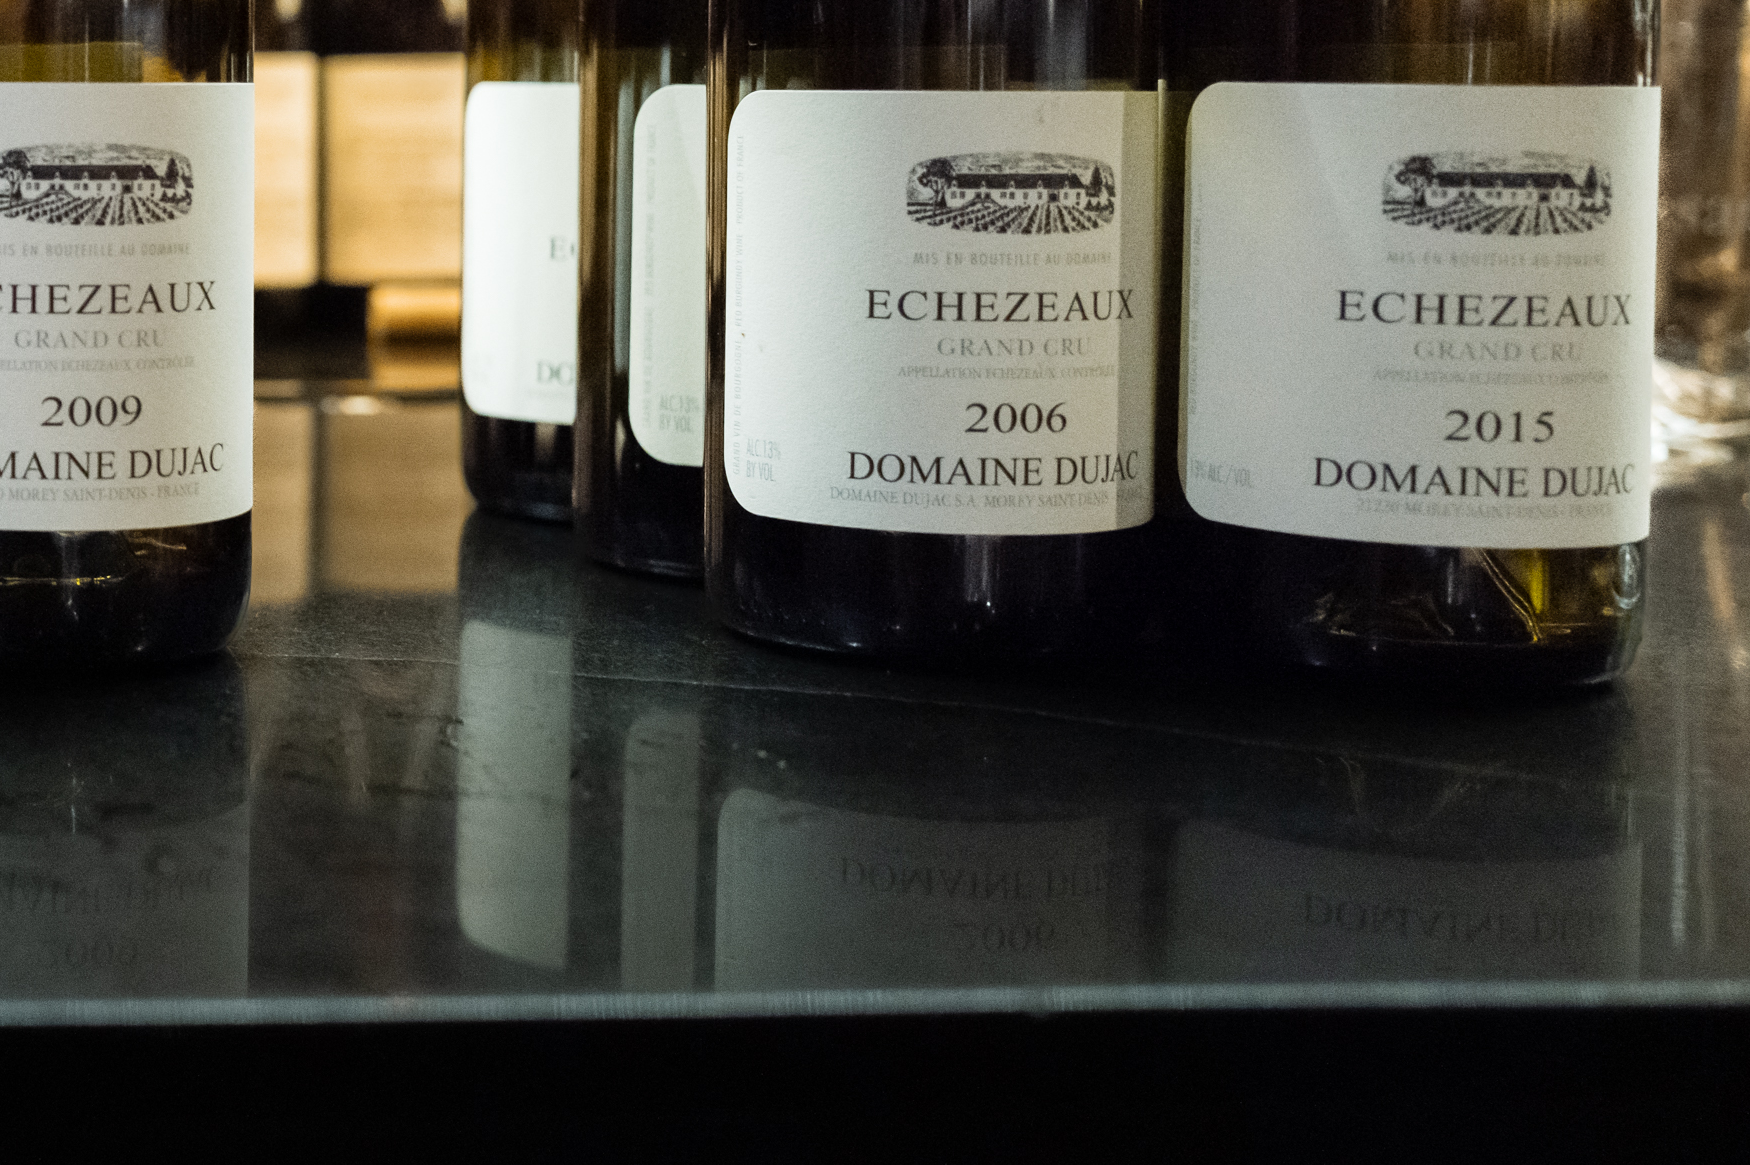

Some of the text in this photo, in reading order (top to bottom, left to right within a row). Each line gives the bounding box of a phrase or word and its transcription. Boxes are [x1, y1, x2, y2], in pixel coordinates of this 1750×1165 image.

[22, 243, 38, 256] EN
[46, 242, 113, 257] BOUTEILLE
[913, 252, 939, 265] MIS
[946, 253, 964, 265] EN
[970, 252, 1040, 266] BOUTEILLE
[1045, 252, 1061, 265] AU
[866, 288, 1134, 323] ECHEZEAUX
[1335, 288, 1633, 327] ECHEZEAUX
[14, 329, 165, 350] GRAND CRU
[936, 336, 1092, 357] GRAND CRU
[1413, 339, 1582, 362] GRAND CRU
[41, 395, 143, 428] 2009
[964, 402, 1068, 434] 2006
[1444, 409, 1554, 443] 2015
[129, 442, 225, 479] DUJAC
[746, 460, 756, 478] BY
[847, 449, 1140, 487] DOMAINE DUJAC
[1313, 456, 1636, 498] DOMAINE DUJAC
[7, 486, 59, 503] MOREY
[157, 482, 201, 499] FRANCE
[829, 485, 899, 505] DOMAINE
[902, 492, 951, 508] DUJAC
[983, 494, 1037, 509] MOREY
